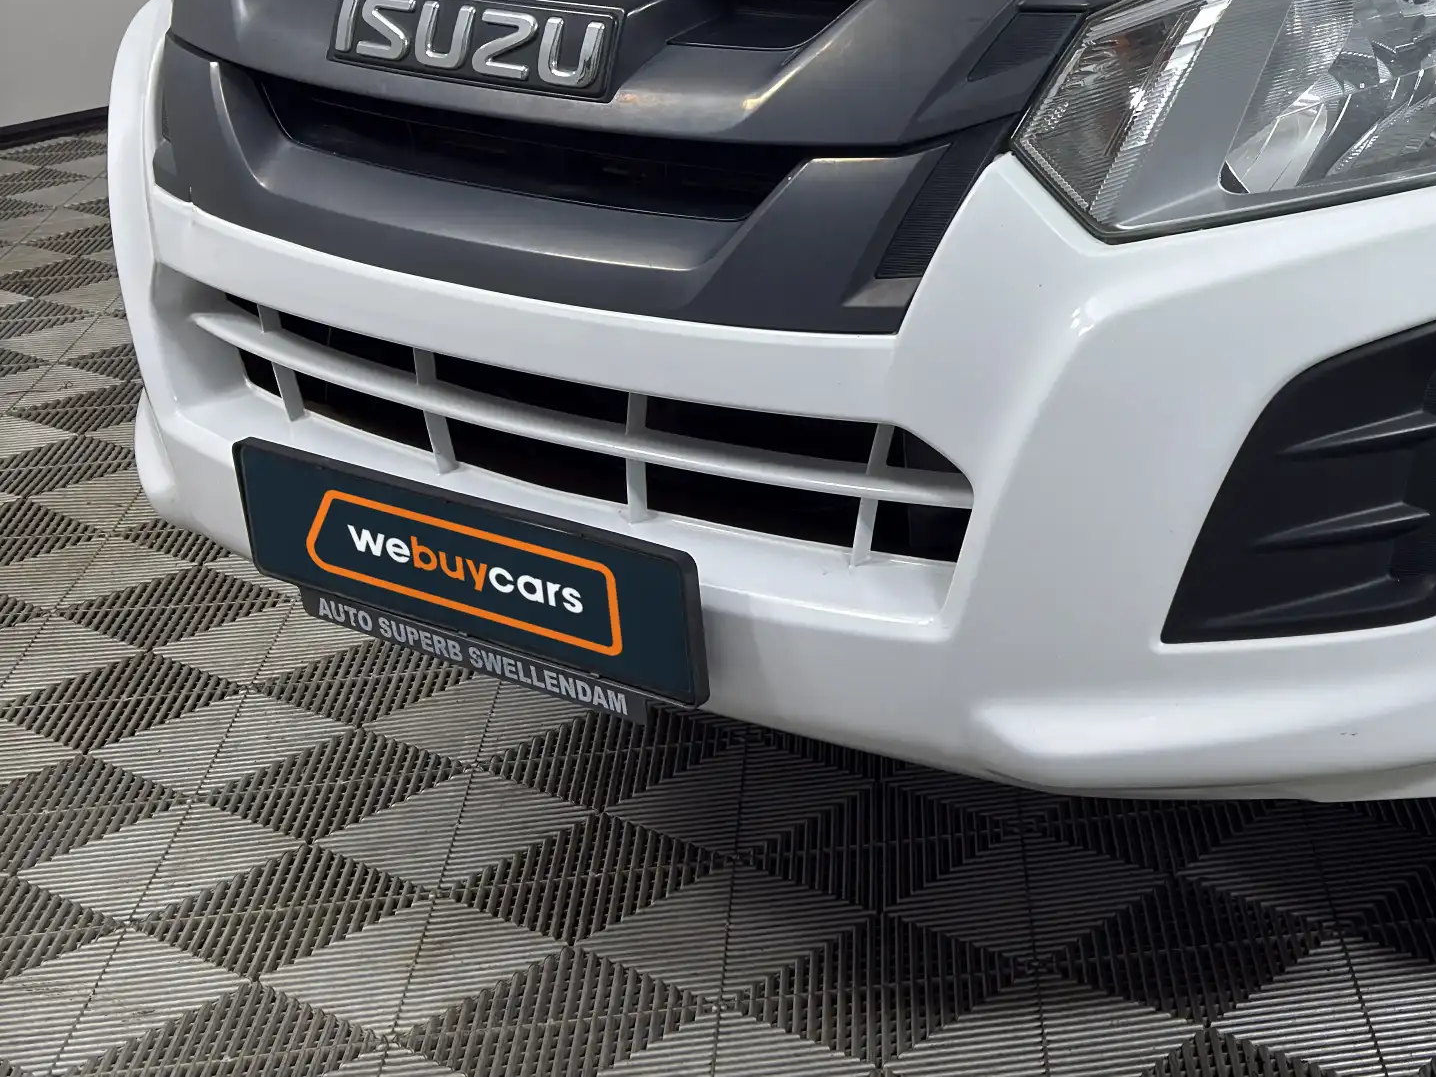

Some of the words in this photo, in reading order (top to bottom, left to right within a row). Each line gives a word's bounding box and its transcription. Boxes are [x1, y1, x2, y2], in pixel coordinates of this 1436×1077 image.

[347, 524, 583, 613] webuycars
[318, 598, 373, 631] AUTO
[378, 616, 463, 662] SUPERB
[469, 646, 629, 716] SWELLENDAM
